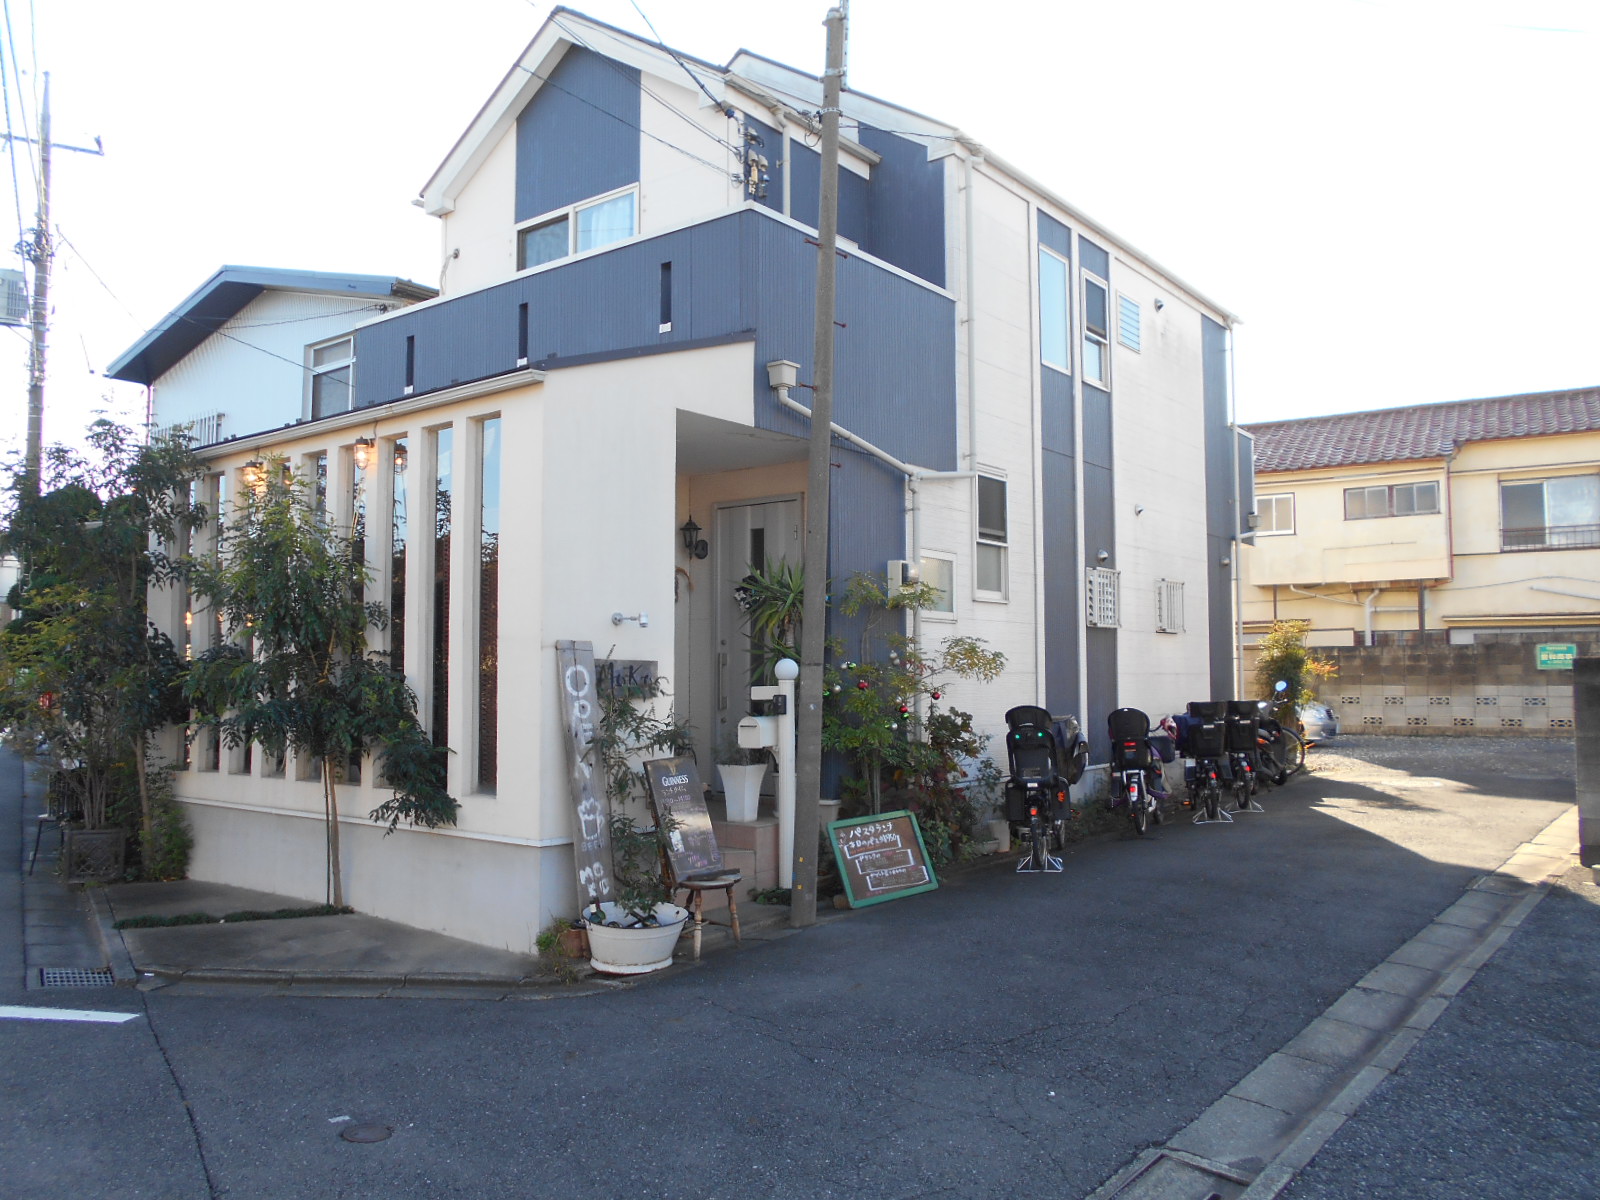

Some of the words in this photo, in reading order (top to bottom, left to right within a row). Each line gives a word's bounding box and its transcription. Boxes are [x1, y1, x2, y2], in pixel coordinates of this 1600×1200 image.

[661, 774, 689, 787] GUINNESS
[850, 821, 892, 839] パスタランチ
